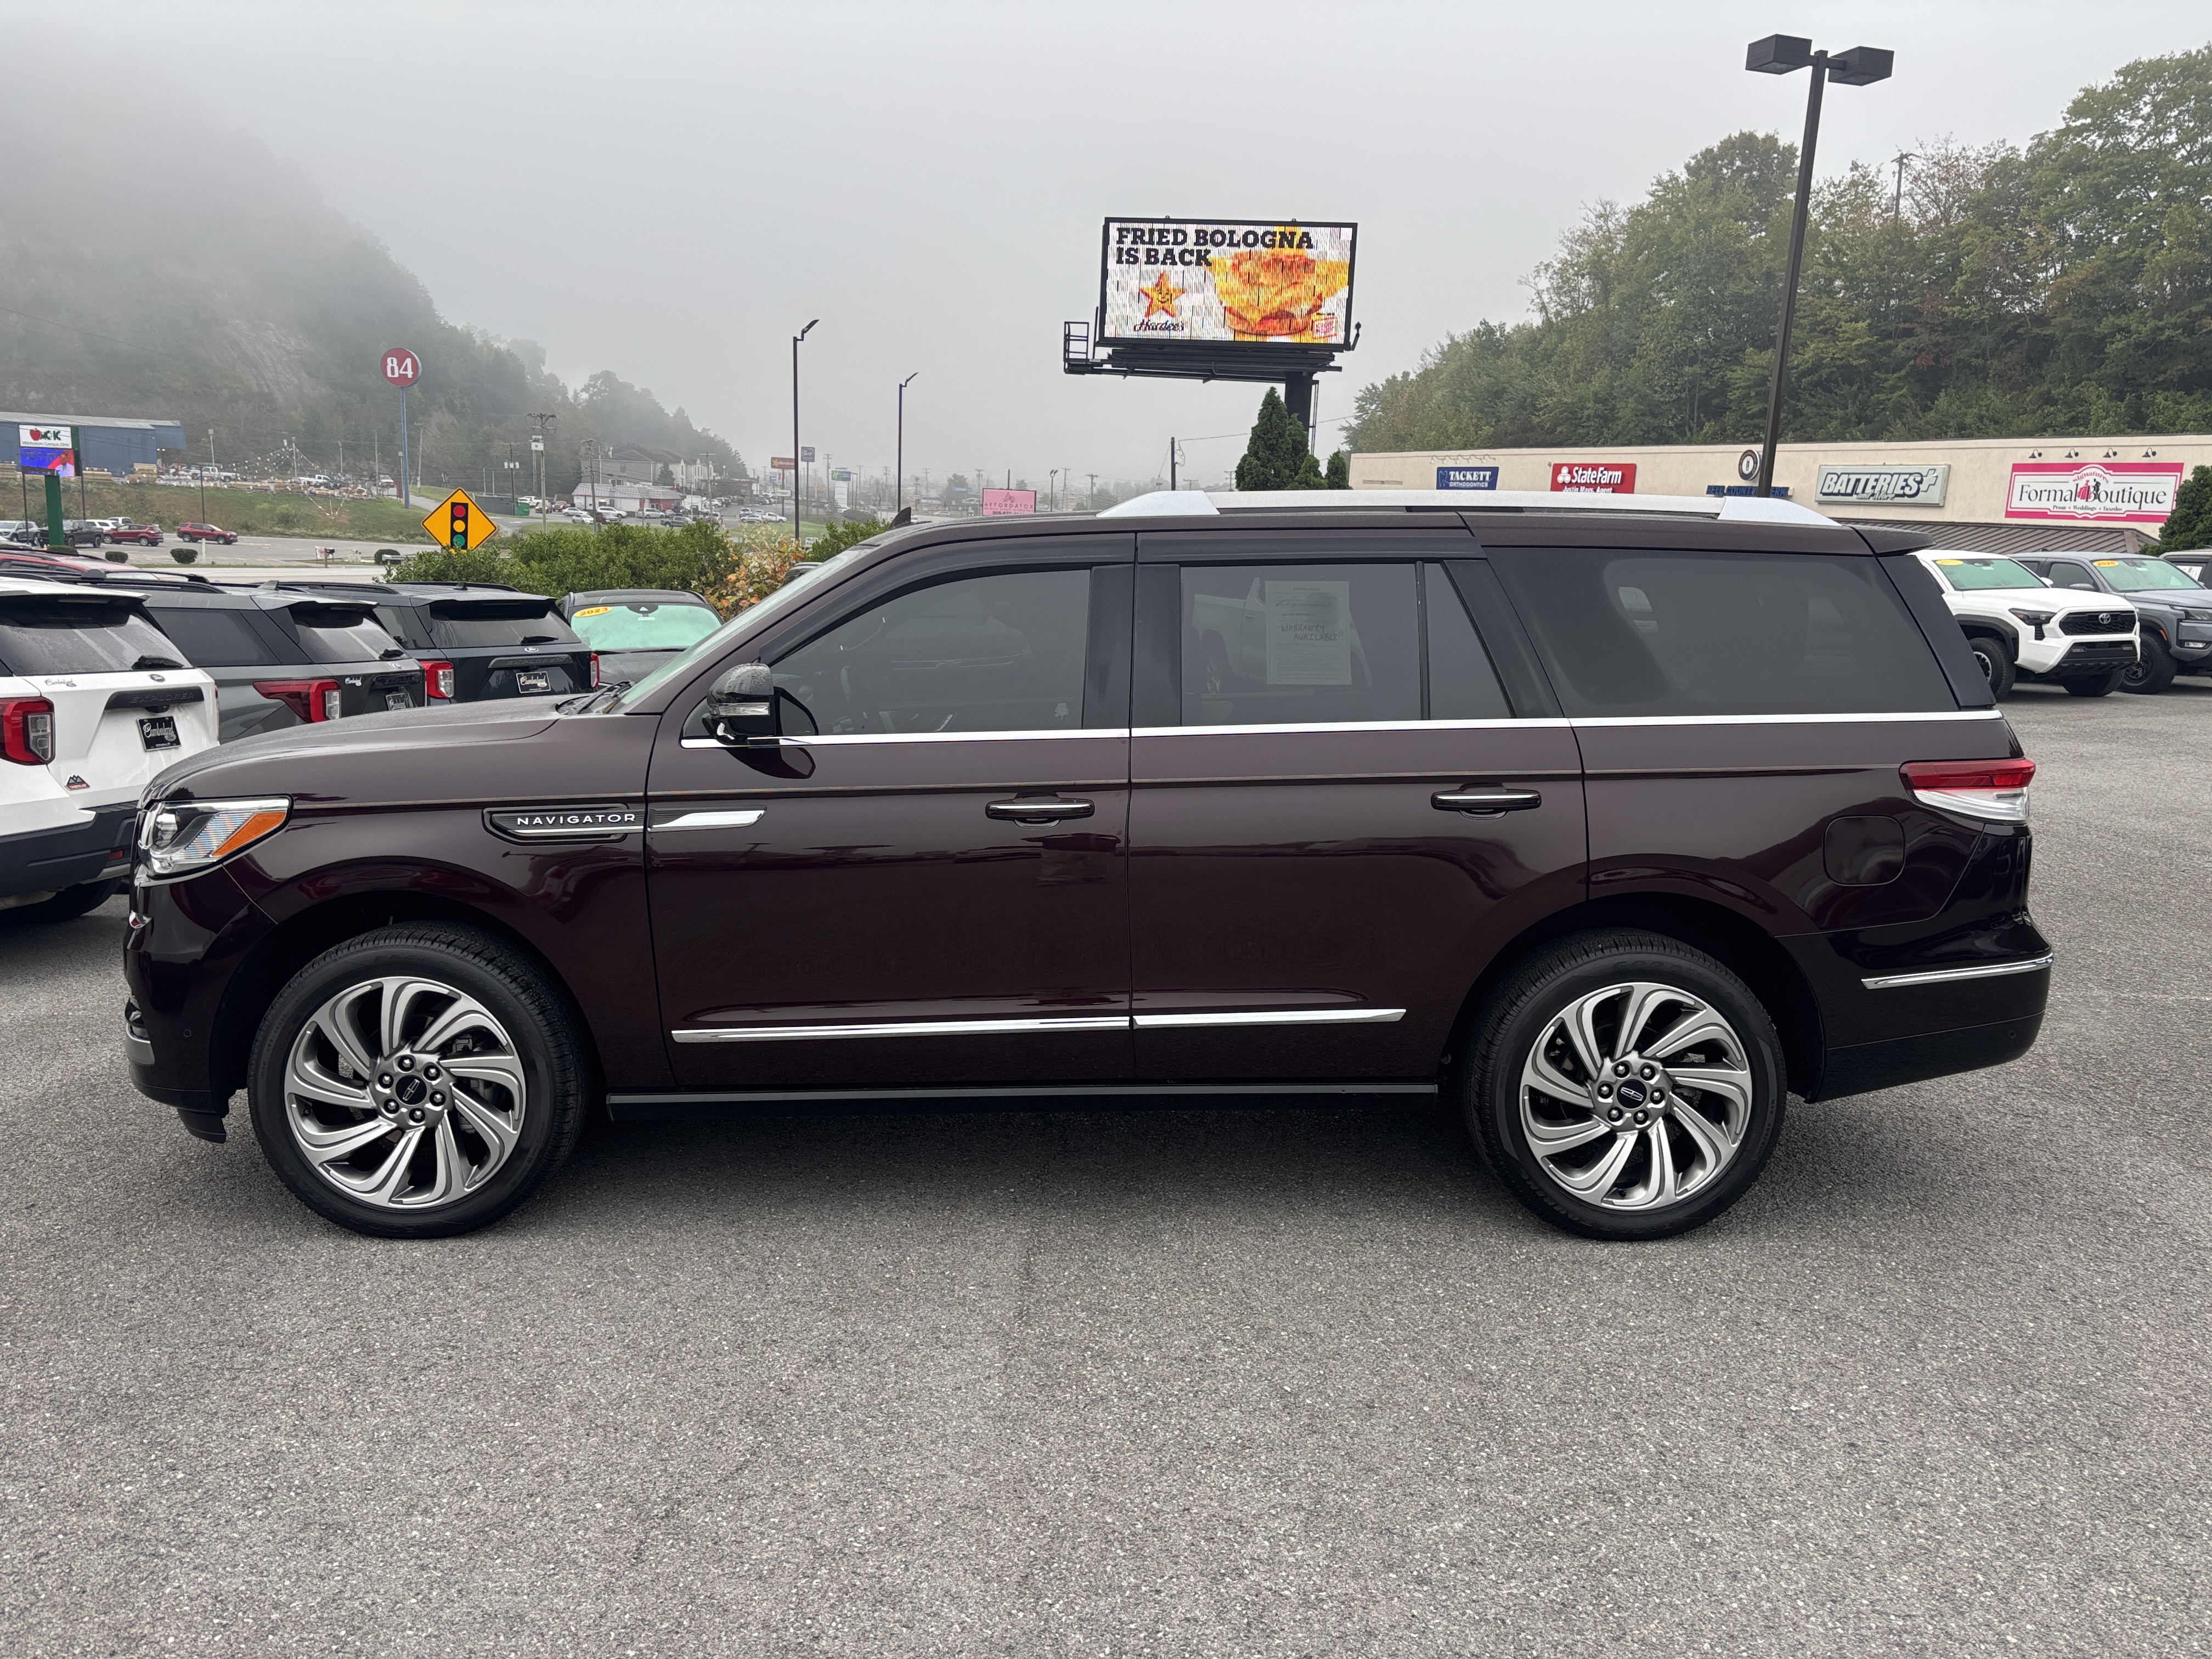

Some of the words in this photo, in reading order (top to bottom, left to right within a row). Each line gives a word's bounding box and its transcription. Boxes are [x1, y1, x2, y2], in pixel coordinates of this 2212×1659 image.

[1116, 228, 1188, 246] FRIED
[1194, 229, 1314, 249] BOLOGNA
[1116, 247, 1138, 264] IS
[1144, 249, 1212, 267] BACK
[387, 357, 414, 379] 84
[1448, 471, 1491, 481] TACKETT
[1706, 486, 1725, 494] BELL
[1726, 486, 1759, 495] COUNTY
[2018, 483, 2079, 502] Formal
[2086, 485, 2167, 510] Boutique
[579, 607, 608, 617] 2023
[1281, 624, 1325, 632] WARRANTY
[1293, 631, 1344, 641] AVAILABLE!!
[506, 656, 565, 665] EXPLORER
[129, 692, 195, 704] EXPLORER
[517, 813, 636, 826] NAVIGATOR
[374, 953, 450, 969] EAGLE
[458, 967, 533, 1039] TOURING
